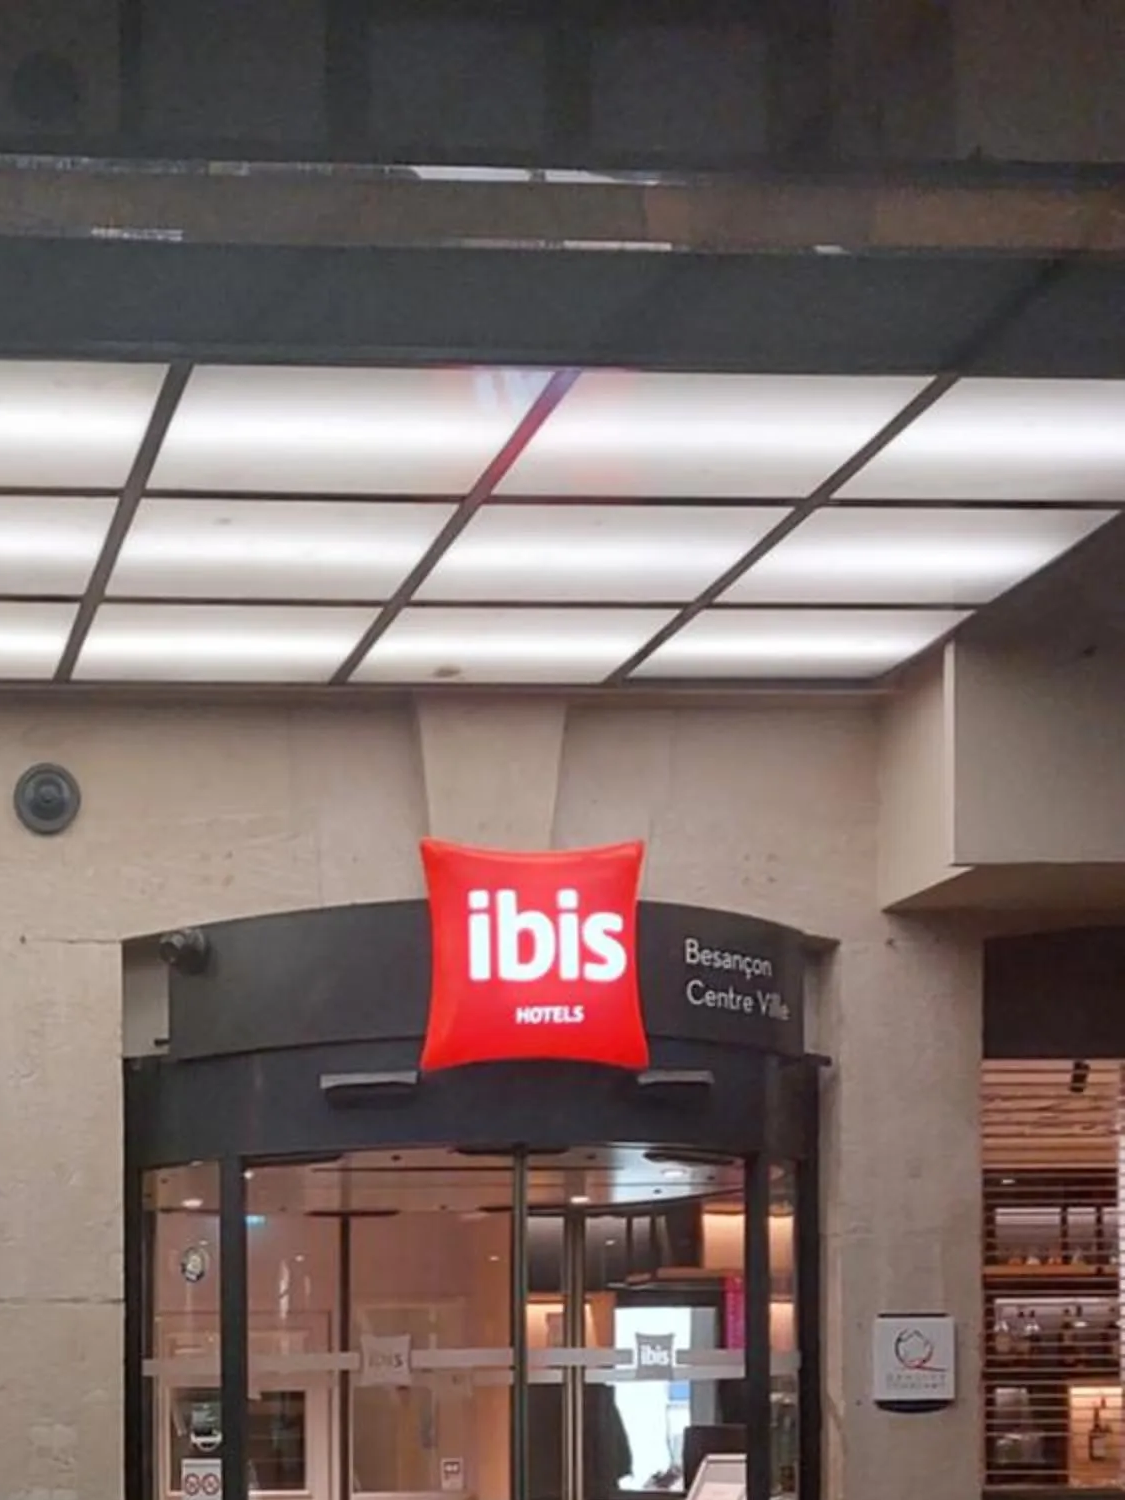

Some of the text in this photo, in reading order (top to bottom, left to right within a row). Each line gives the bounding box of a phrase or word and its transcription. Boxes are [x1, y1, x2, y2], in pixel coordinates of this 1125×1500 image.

[468, 889, 627, 982] ibis
[684, 937, 774, 980] Besançon
[515, 1005, 585, 1024] HOTELS
[686, 979, 791, 1020] Centre Ville
[639, 1344, 670, 1366] ibis
